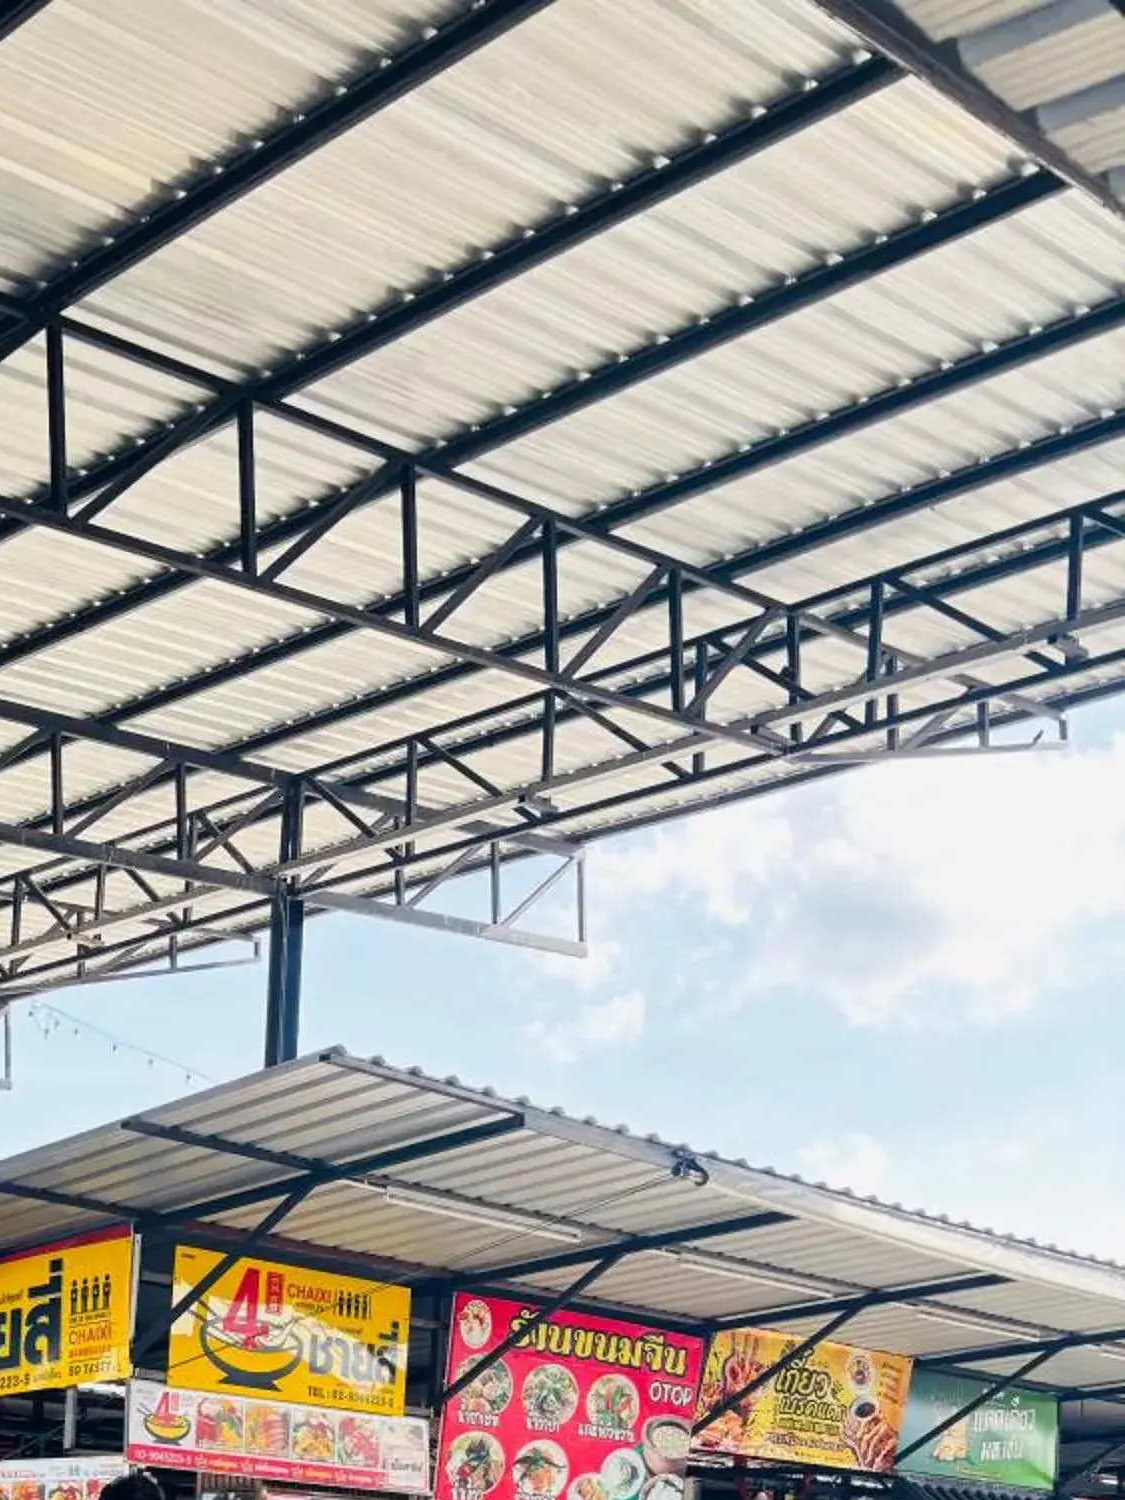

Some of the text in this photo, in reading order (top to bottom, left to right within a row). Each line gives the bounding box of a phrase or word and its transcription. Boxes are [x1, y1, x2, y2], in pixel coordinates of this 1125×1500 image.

[308, 1320, 400, 1386] ชายสี่
[649, 1380, 695, 1407] OTOP
